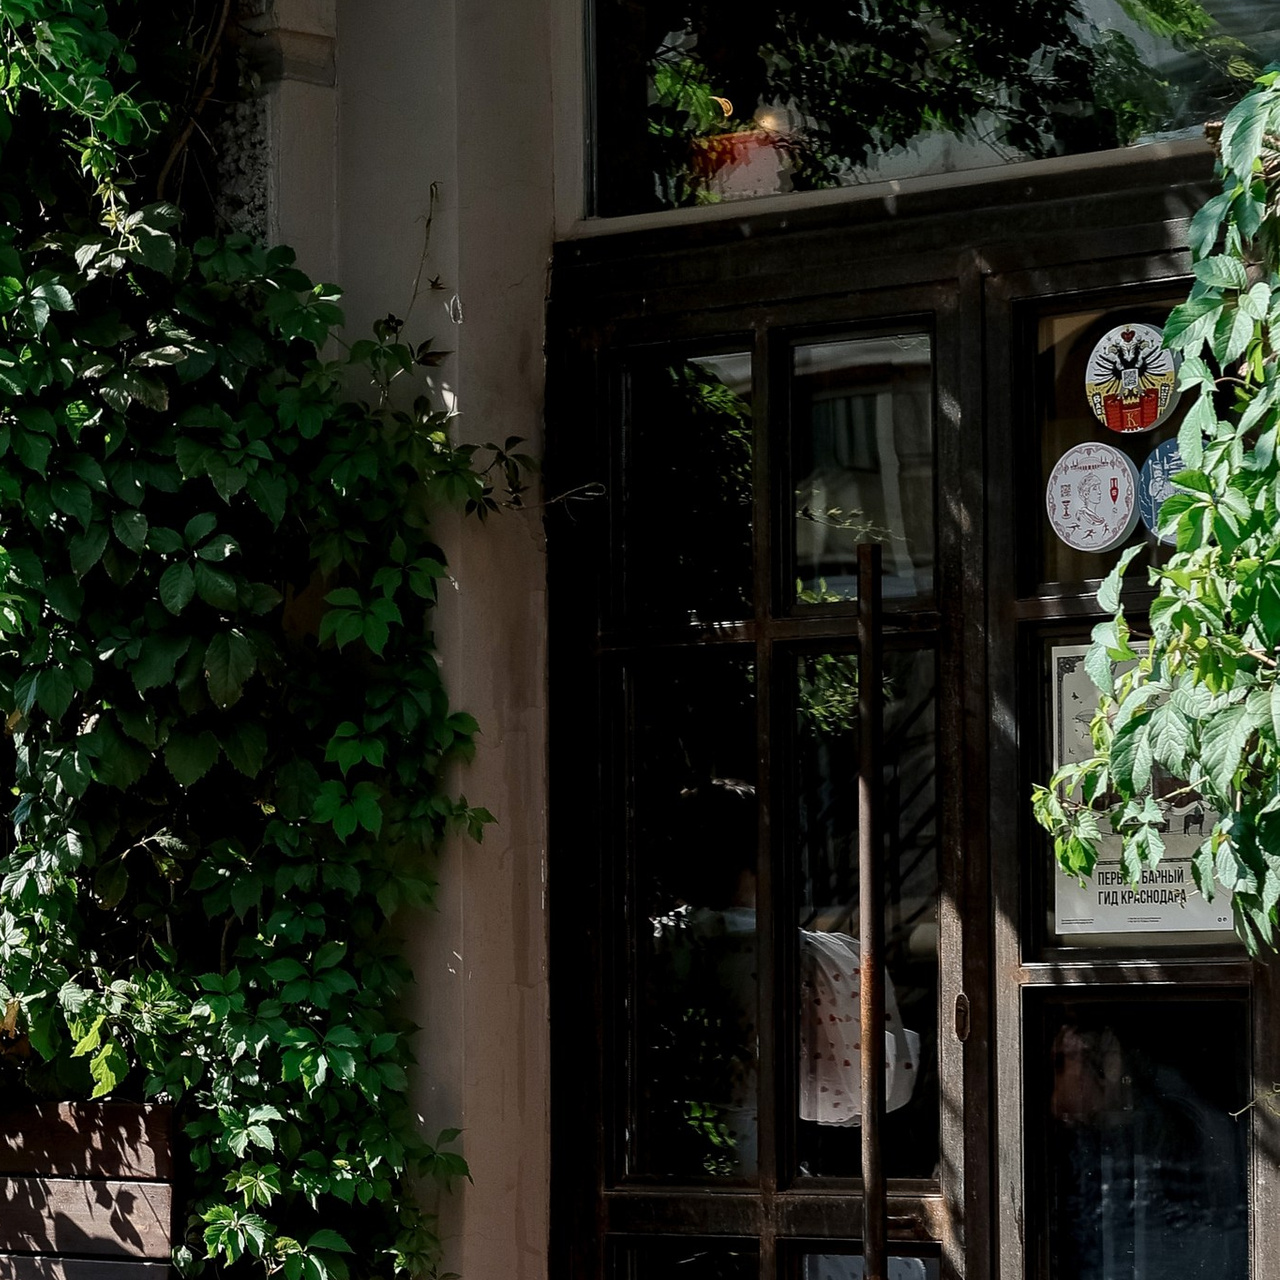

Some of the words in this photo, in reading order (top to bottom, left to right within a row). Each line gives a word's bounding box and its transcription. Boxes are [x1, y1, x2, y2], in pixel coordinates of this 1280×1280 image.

[1098, 871, 1139, 885] ПЕРВ
[1141, 866, 1184, 884] БАРНЫЙ
[1098, 890, 1118, 906] ГИД
